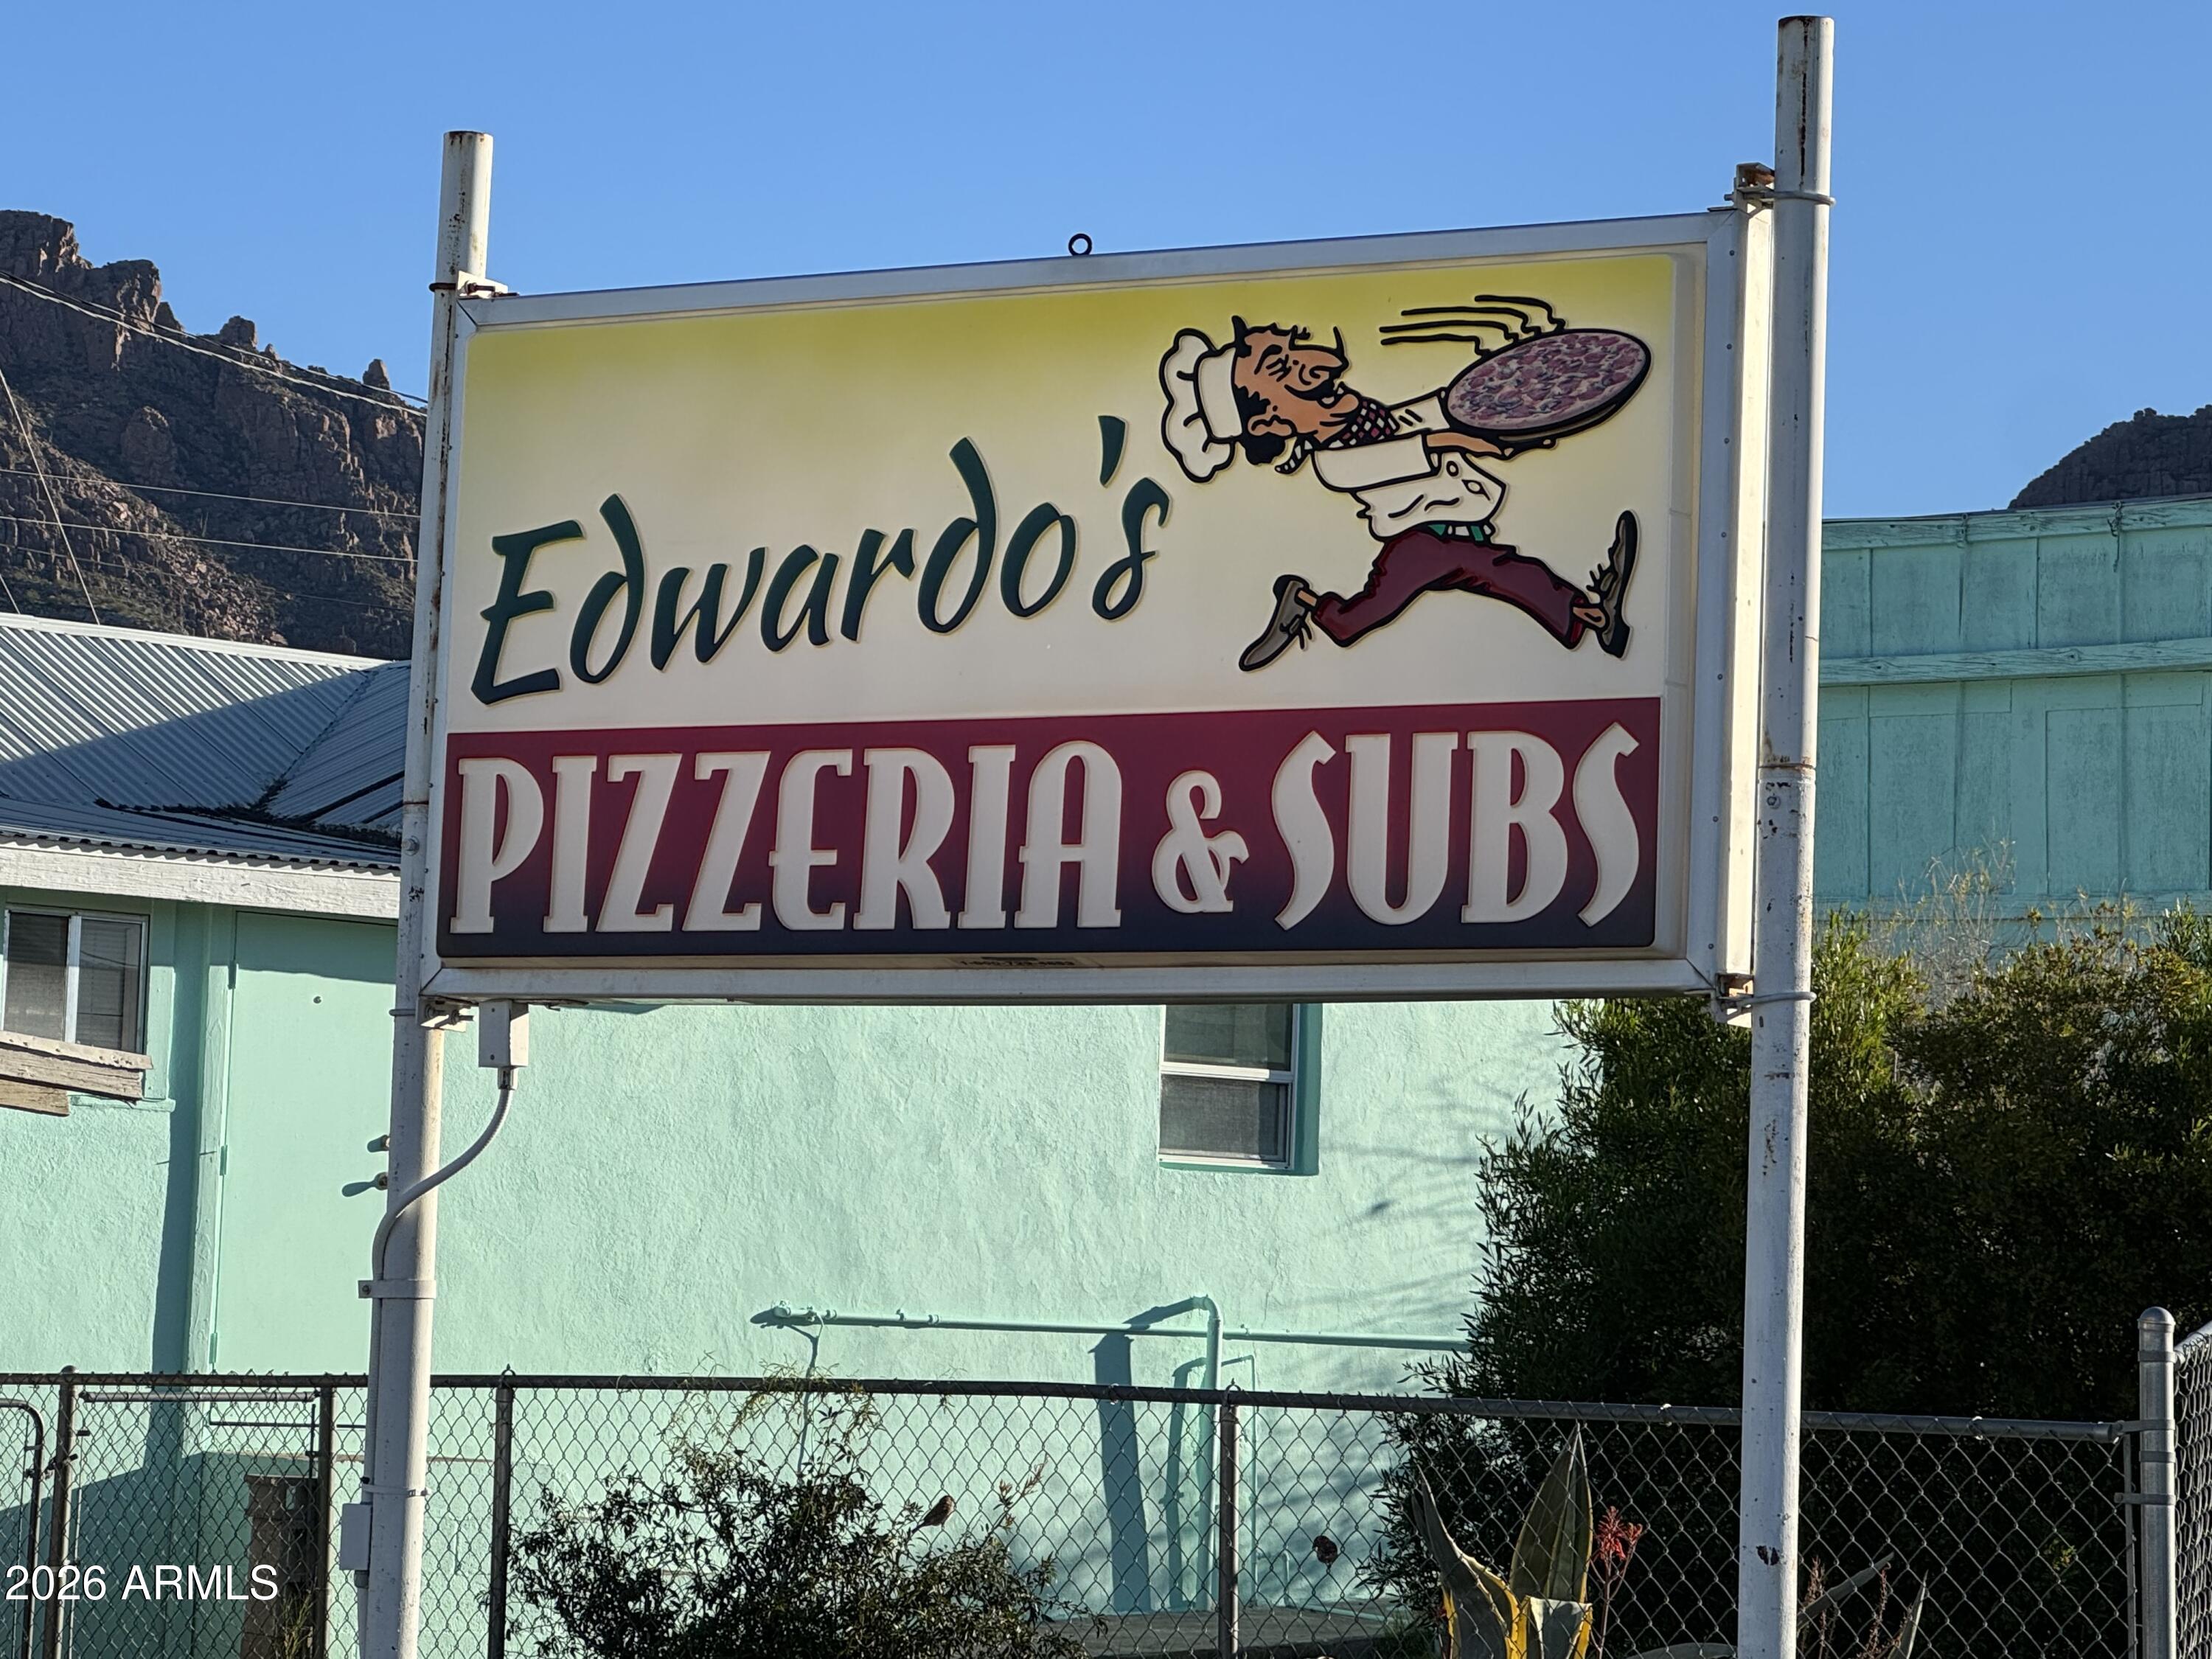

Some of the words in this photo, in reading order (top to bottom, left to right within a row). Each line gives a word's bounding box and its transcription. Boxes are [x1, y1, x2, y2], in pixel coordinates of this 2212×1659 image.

[470, 414, 1170, 706] Edwardo's
[449, 740, 1123, 933] PIZZERIA
[1151, 770, 1250, 914] &
[1271, 722, 1640, 931] SUBS
